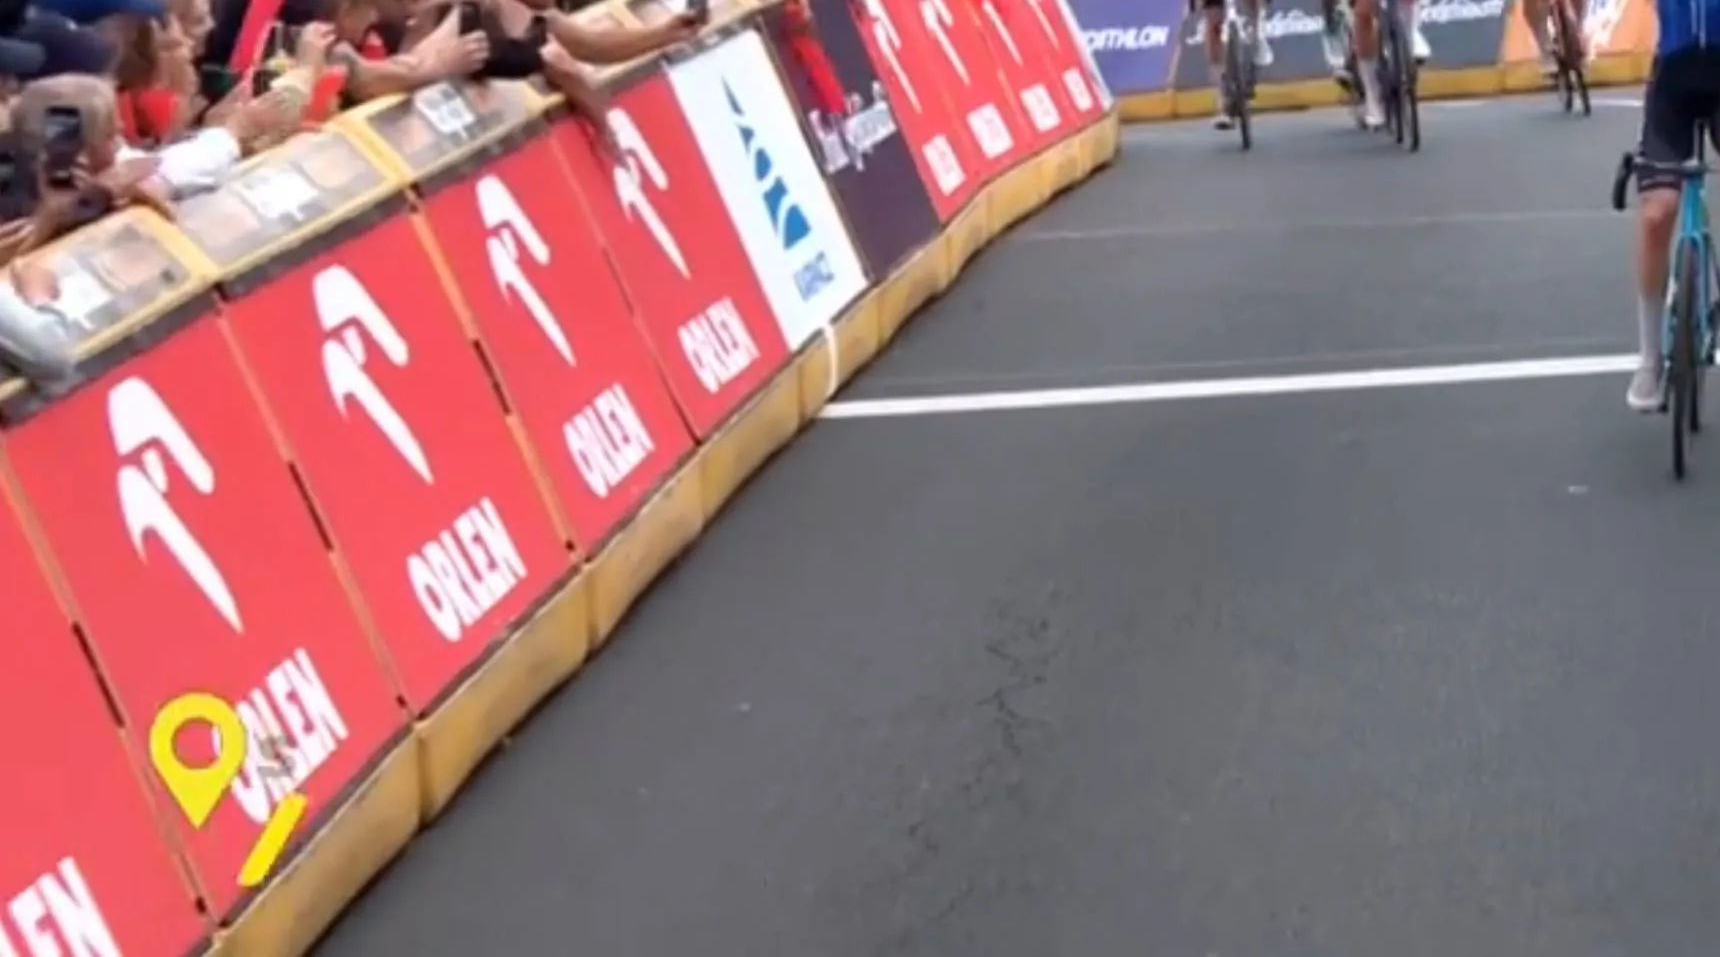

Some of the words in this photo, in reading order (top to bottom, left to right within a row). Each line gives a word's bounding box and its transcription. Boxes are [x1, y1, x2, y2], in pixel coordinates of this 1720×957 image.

[677, 295, 762, 395] ORLEN
[562, 381, 656, 499] ORLEN
[406, 496, 529, 643] ORLEN
